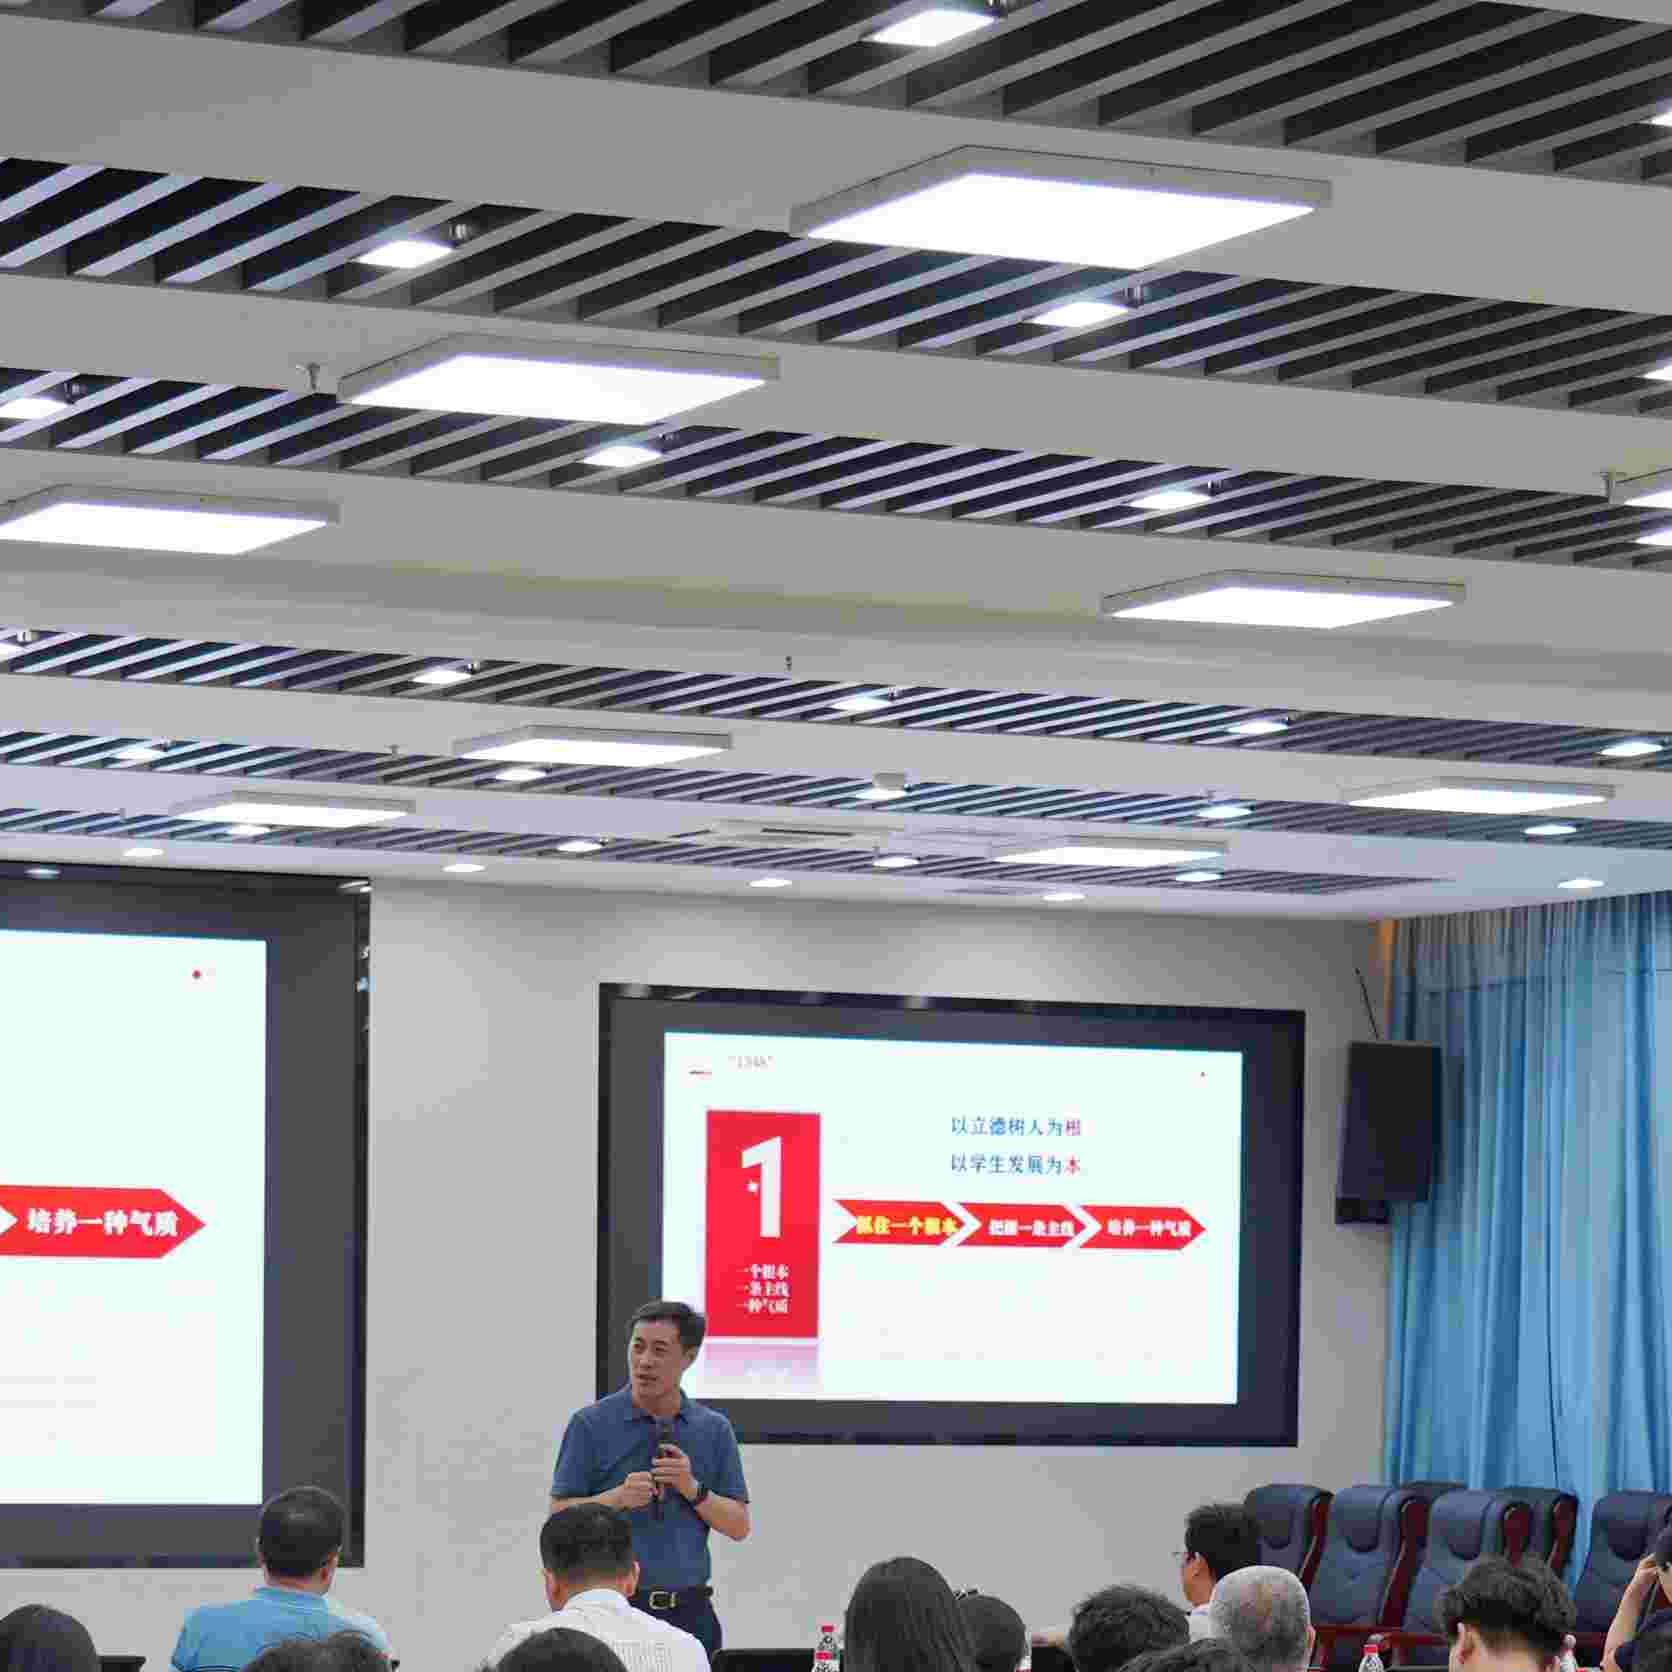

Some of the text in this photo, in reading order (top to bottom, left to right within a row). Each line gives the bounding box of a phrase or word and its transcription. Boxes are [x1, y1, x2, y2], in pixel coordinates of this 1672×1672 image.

[951, 1114, 1081, 1137] 以立德树人为根
[951, 1152, 1081, 1176] 以学生发展为本
[741, 1136, 782, 1238] 1
[28, 1208, 178, 1237] 培养一种气质
